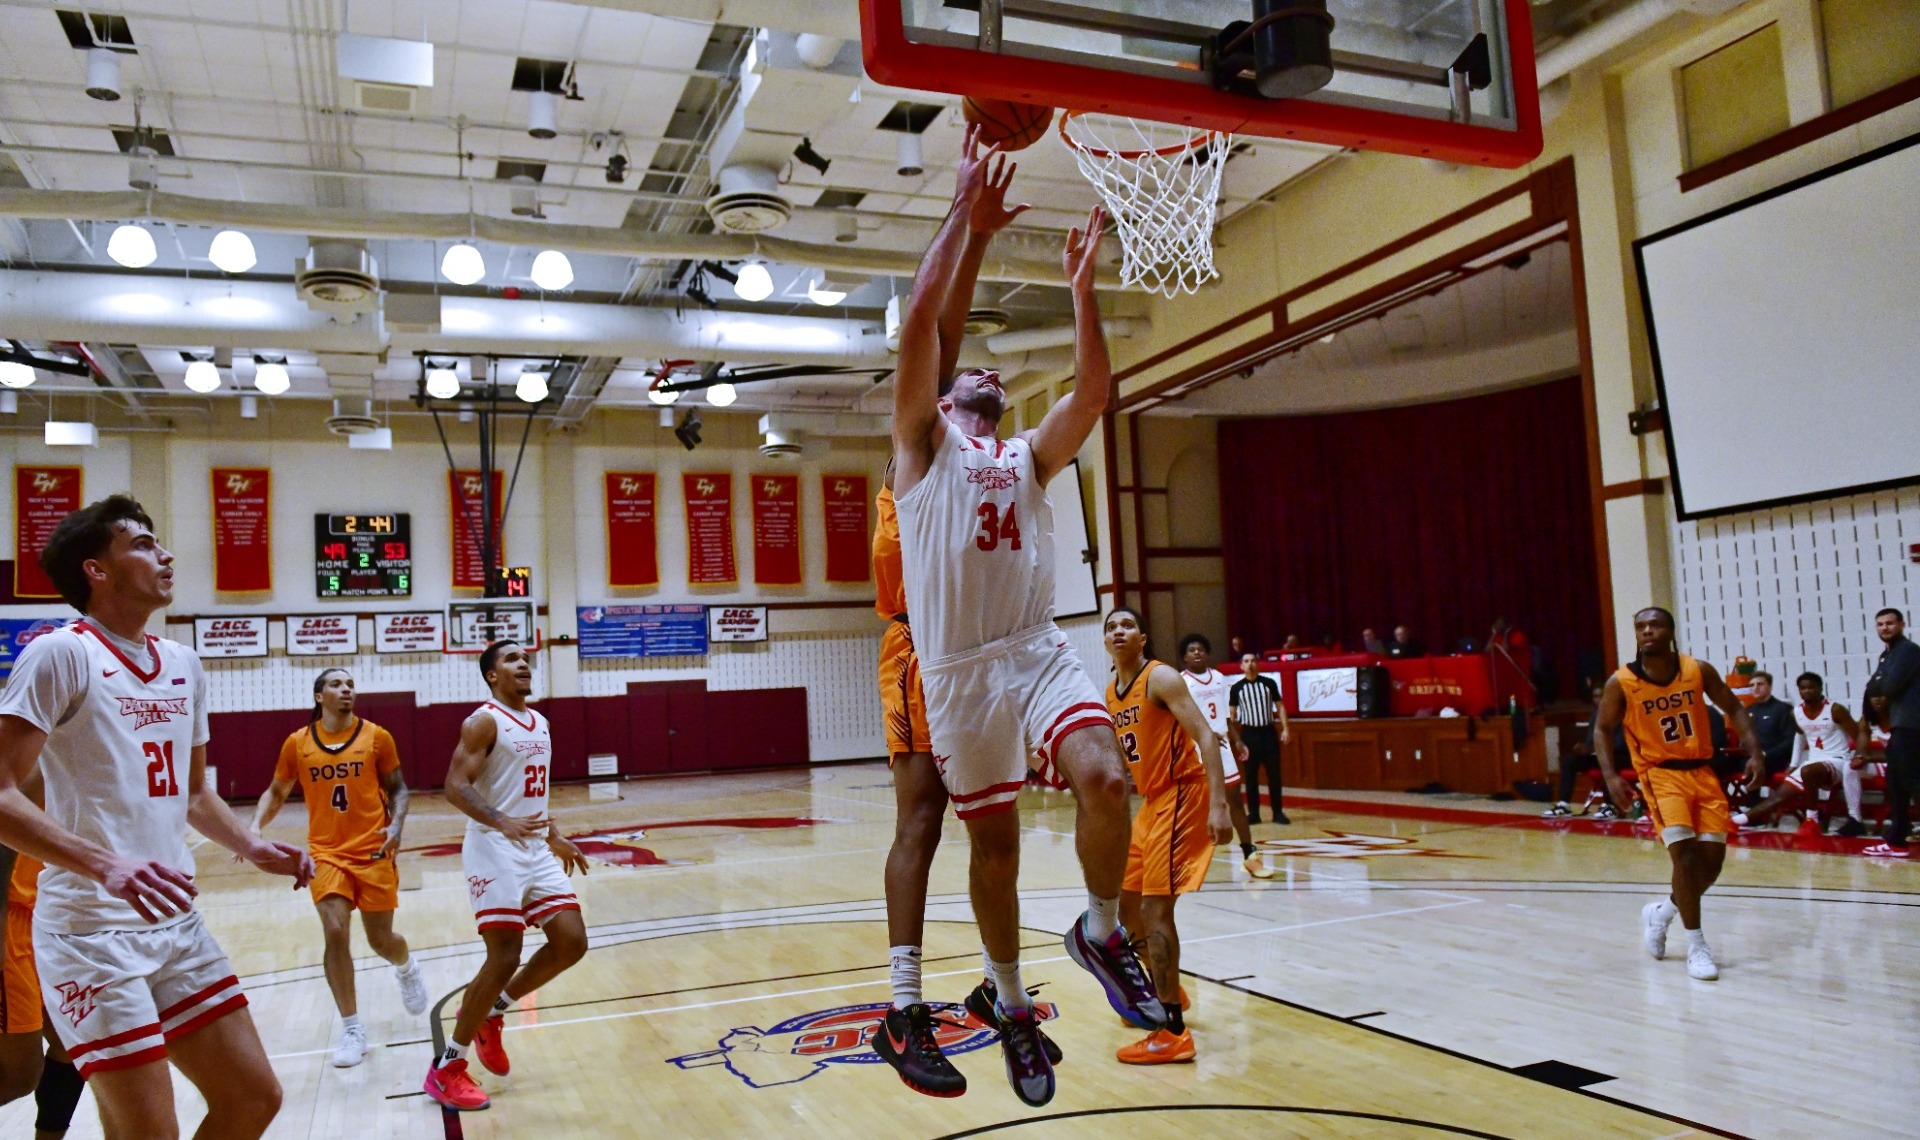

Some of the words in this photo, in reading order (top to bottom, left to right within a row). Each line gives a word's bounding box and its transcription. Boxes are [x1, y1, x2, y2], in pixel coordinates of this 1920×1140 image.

[977, 501, 1022, 551] 34
[324, 543, 346, 560] 49
[384, 542, 406, 559] 53
[317, 560, 349, 568] HOME
[359, 553, 369, 567] 2
[376, 560, 410, 568] VISITOR
[329, 576, 339, 590] 5
[398, 575, 408, 589] 6
[507, 579, 525, 597] 14
[391, 616, 429, 626] CACC
[476, 614, 512, 623] CCC
[723, 609, 754, 618] CACC
[211, 620, 251, 630] CACC
[302, 618, 341, 628] CACC
[1208, 702, 1217, 719] 3
[1642, 689, 1695, 715] POST
[1659, 711, 1694, 743] 21
[142, 740, 179, 798] 21
[309, 762, 364, 782] POST
[524, 764, 546, 797] 23
[331, 784, 349, 813] 4
